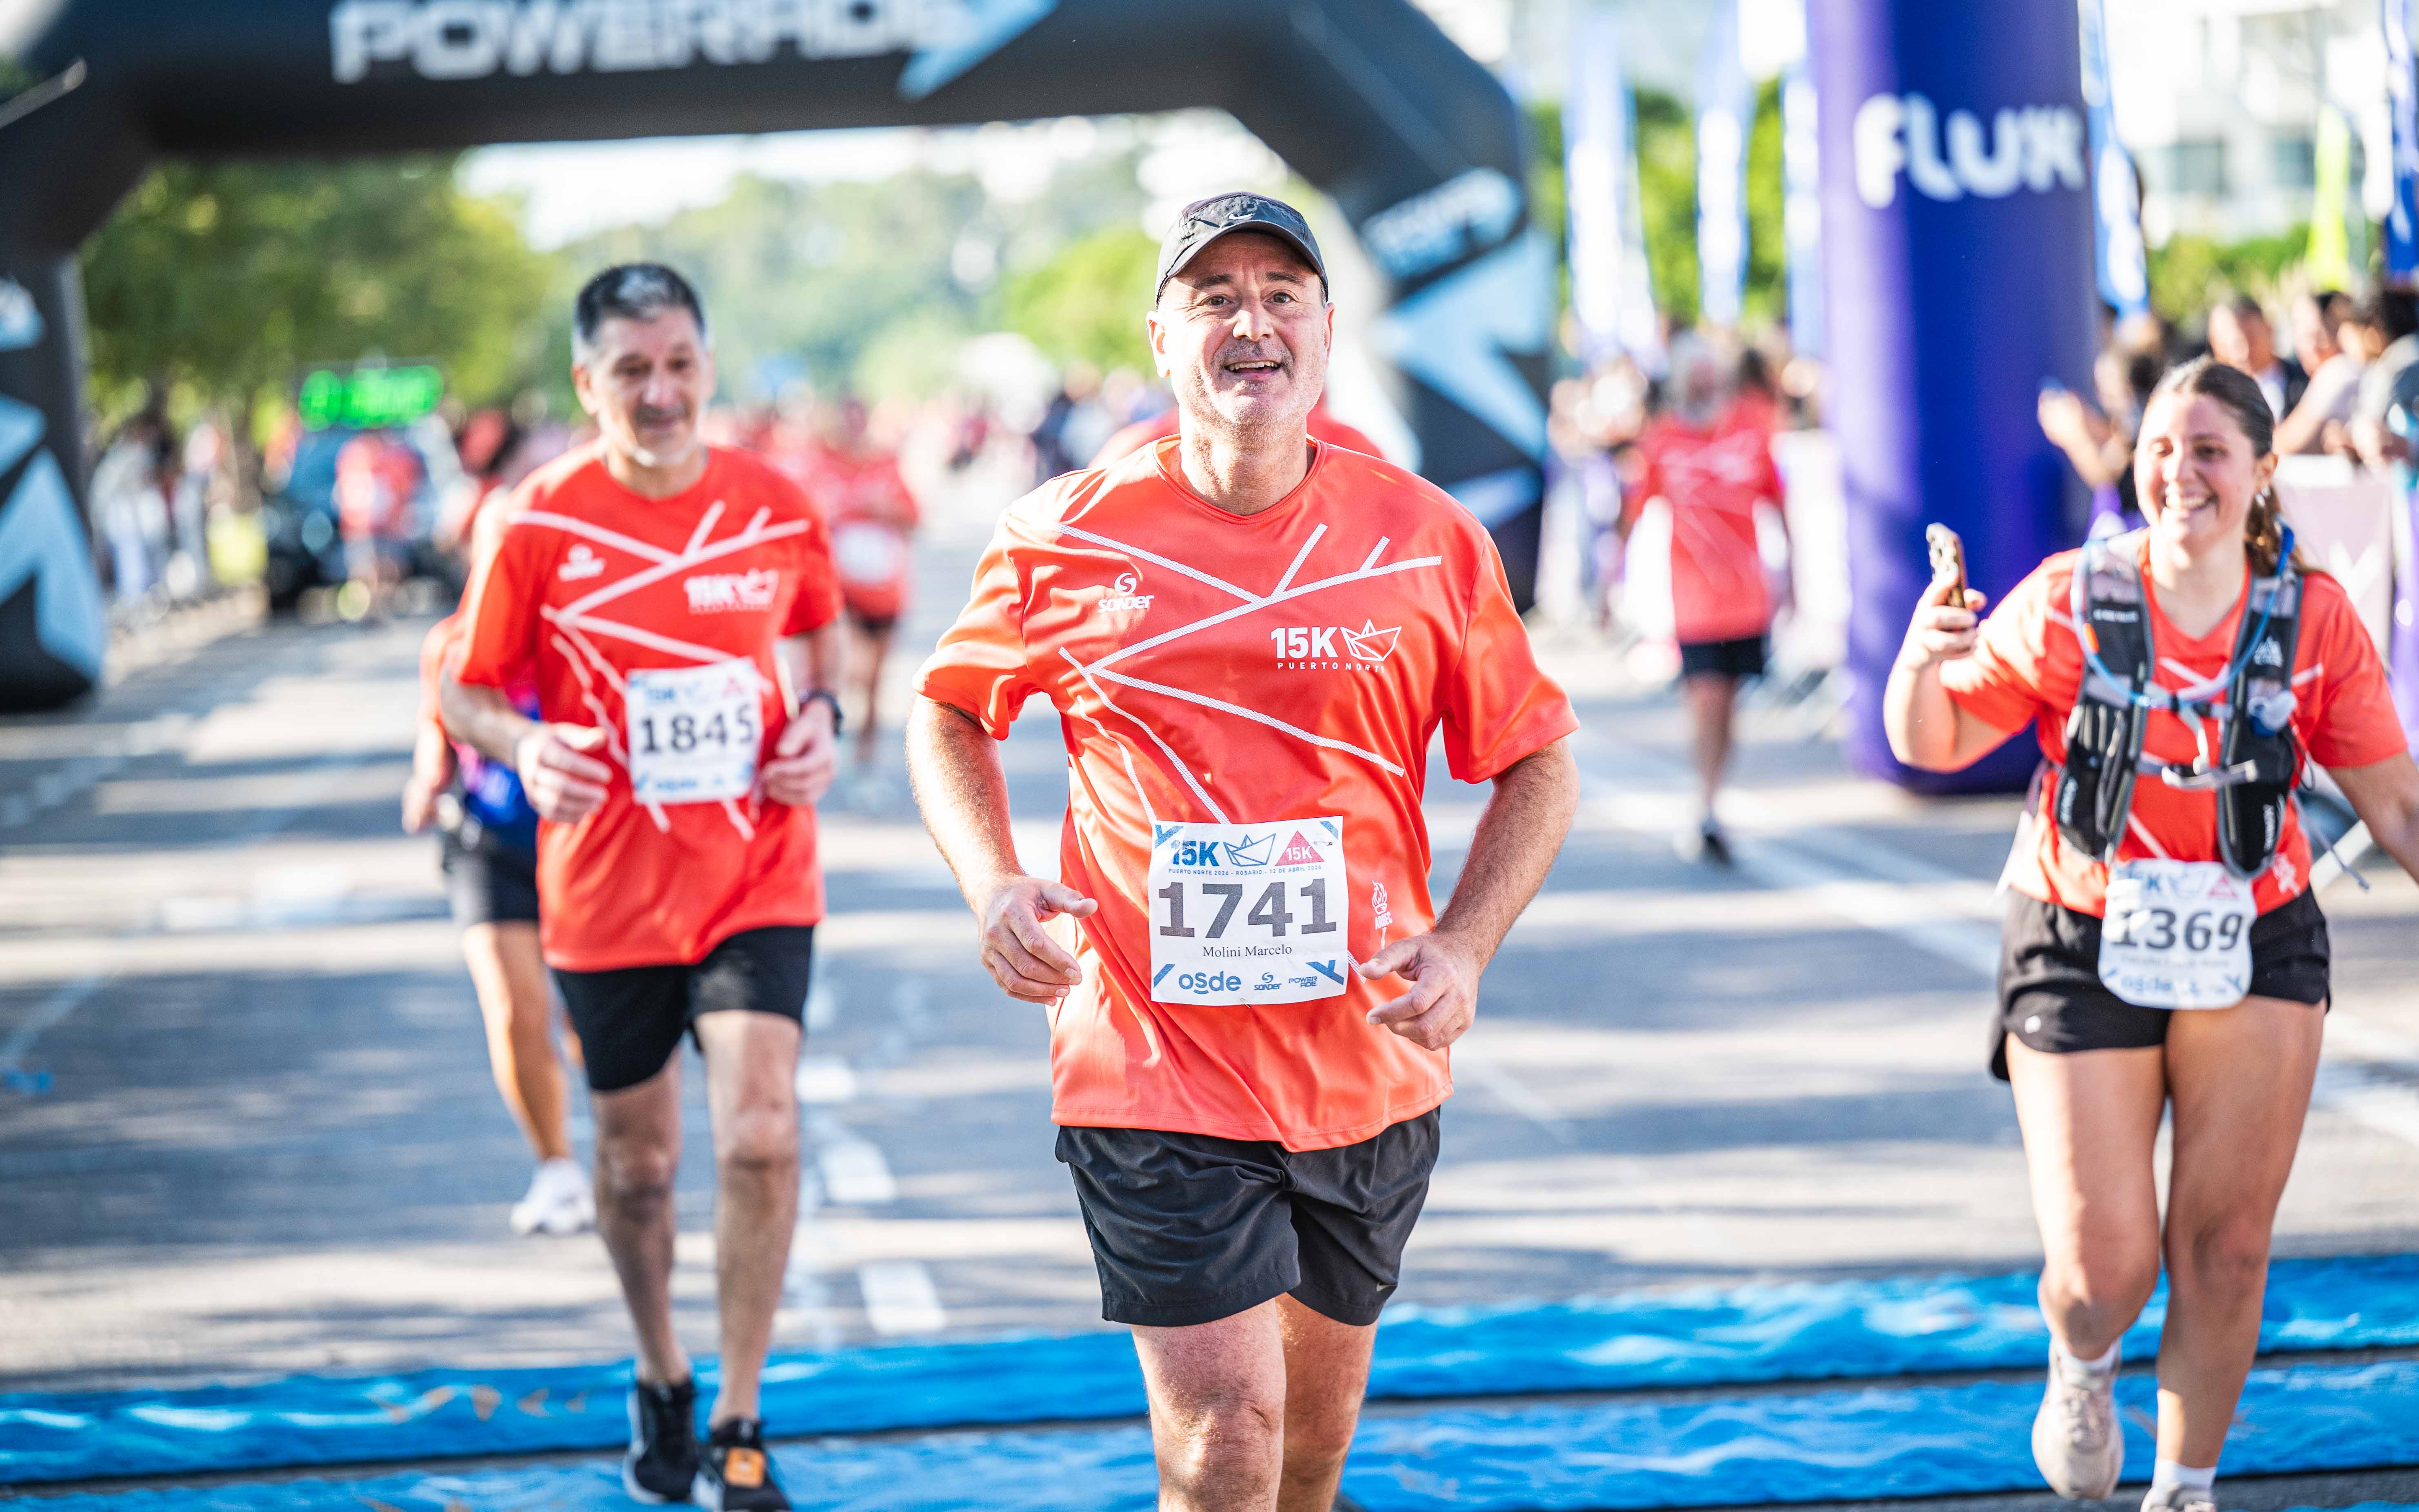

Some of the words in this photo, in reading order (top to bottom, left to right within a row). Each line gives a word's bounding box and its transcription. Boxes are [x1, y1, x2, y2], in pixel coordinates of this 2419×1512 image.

[1853, 91, 2085, 209] FLUX
[1270, 626, 1338, 659] 15K
[641, 703, 753, 755] 1845
[1171, 839, 1219, 867] 15K
[1286, 846, 1313, 861] 15K
[1159, 878, 1337, 939] 1741
[2111, 908, 2243, 952] 1369
[1202, 946, 1241, 957] Molini
[1245, 944, 1292, 956] Marcelo
[1178, 970, 1242, 995] osde
